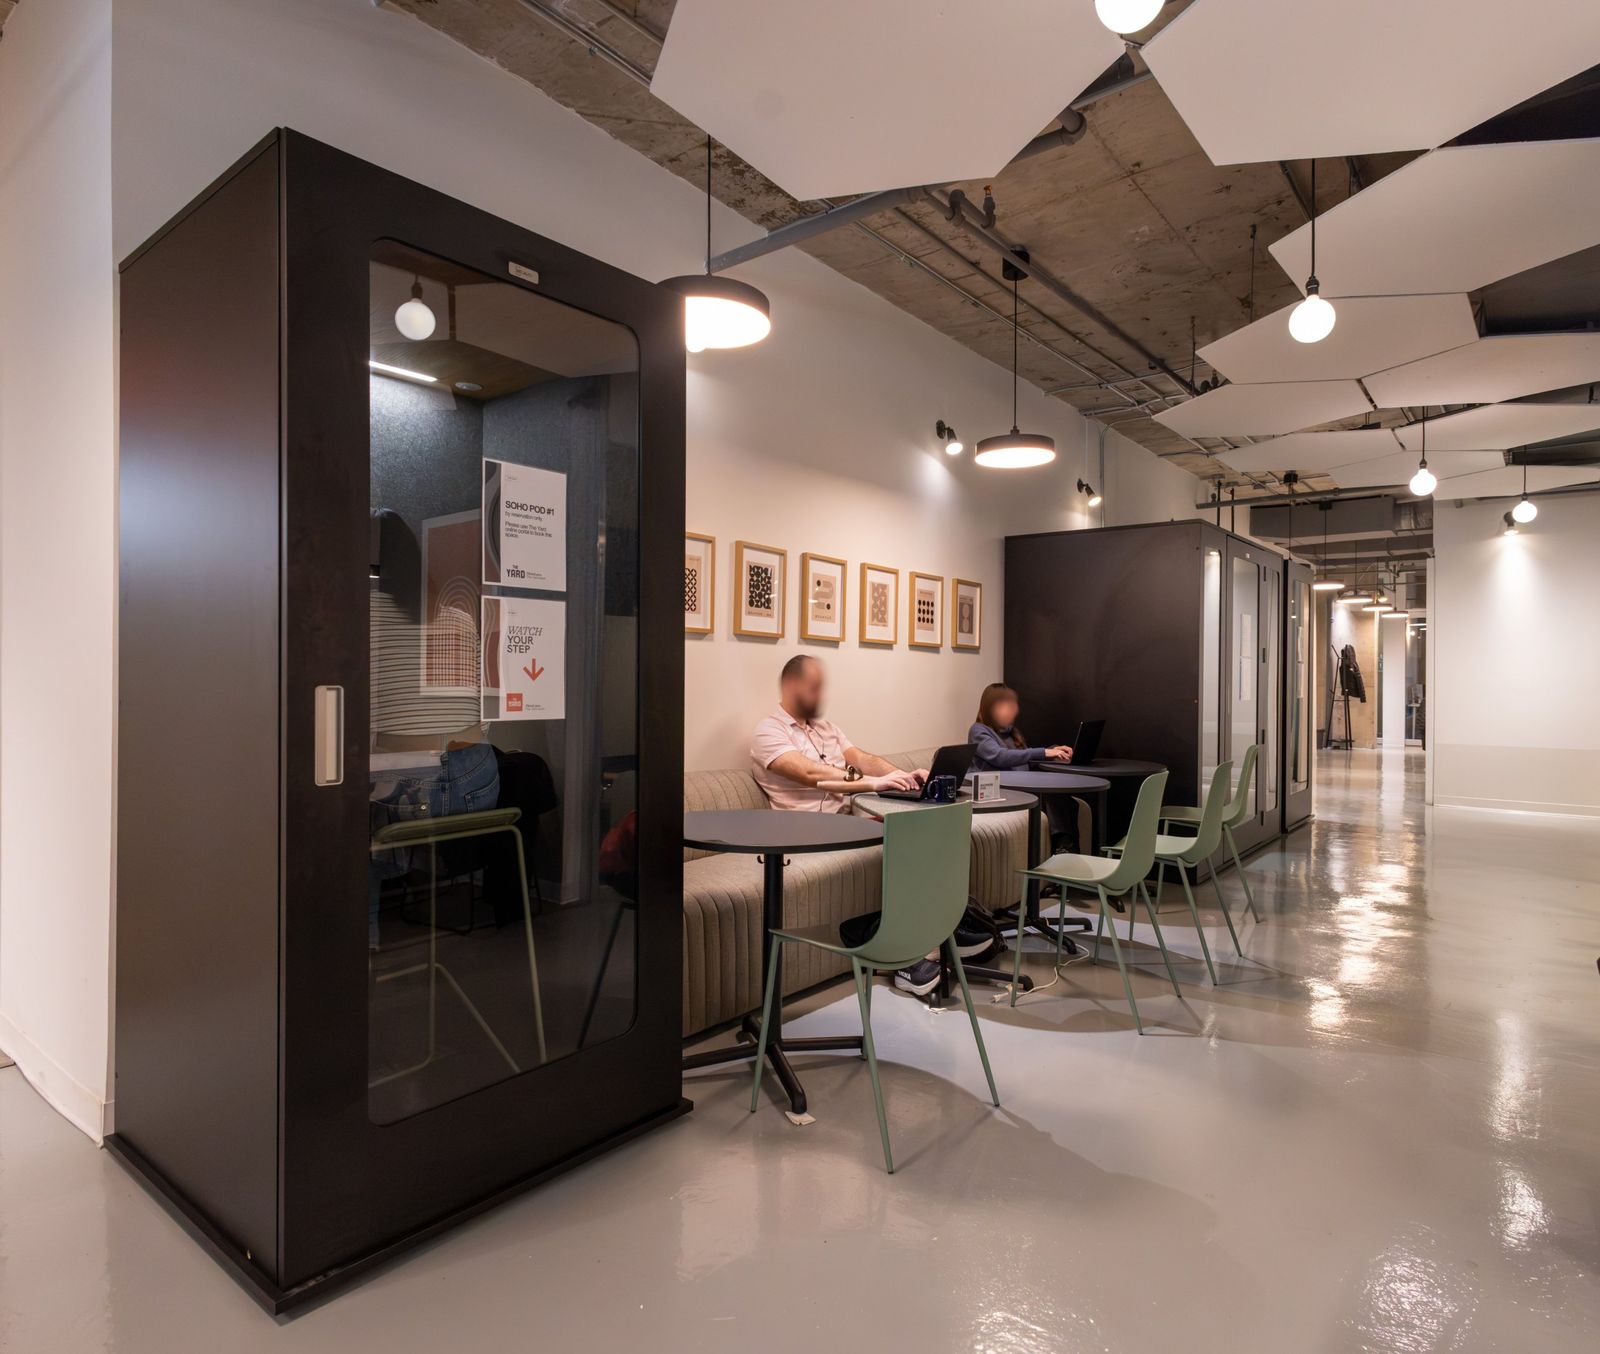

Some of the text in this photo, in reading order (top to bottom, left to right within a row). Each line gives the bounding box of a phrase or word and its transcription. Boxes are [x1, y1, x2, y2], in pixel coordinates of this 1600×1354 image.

[505, 500, 528, 511] SOHO
[529, 505, 546, 514] POD
[506, 569, 525, 578] YARD
[508, 625, 542, 636] WATCH
[507, 635, 534, 644] YOUR
[507, 644, 530, 653] STEP
